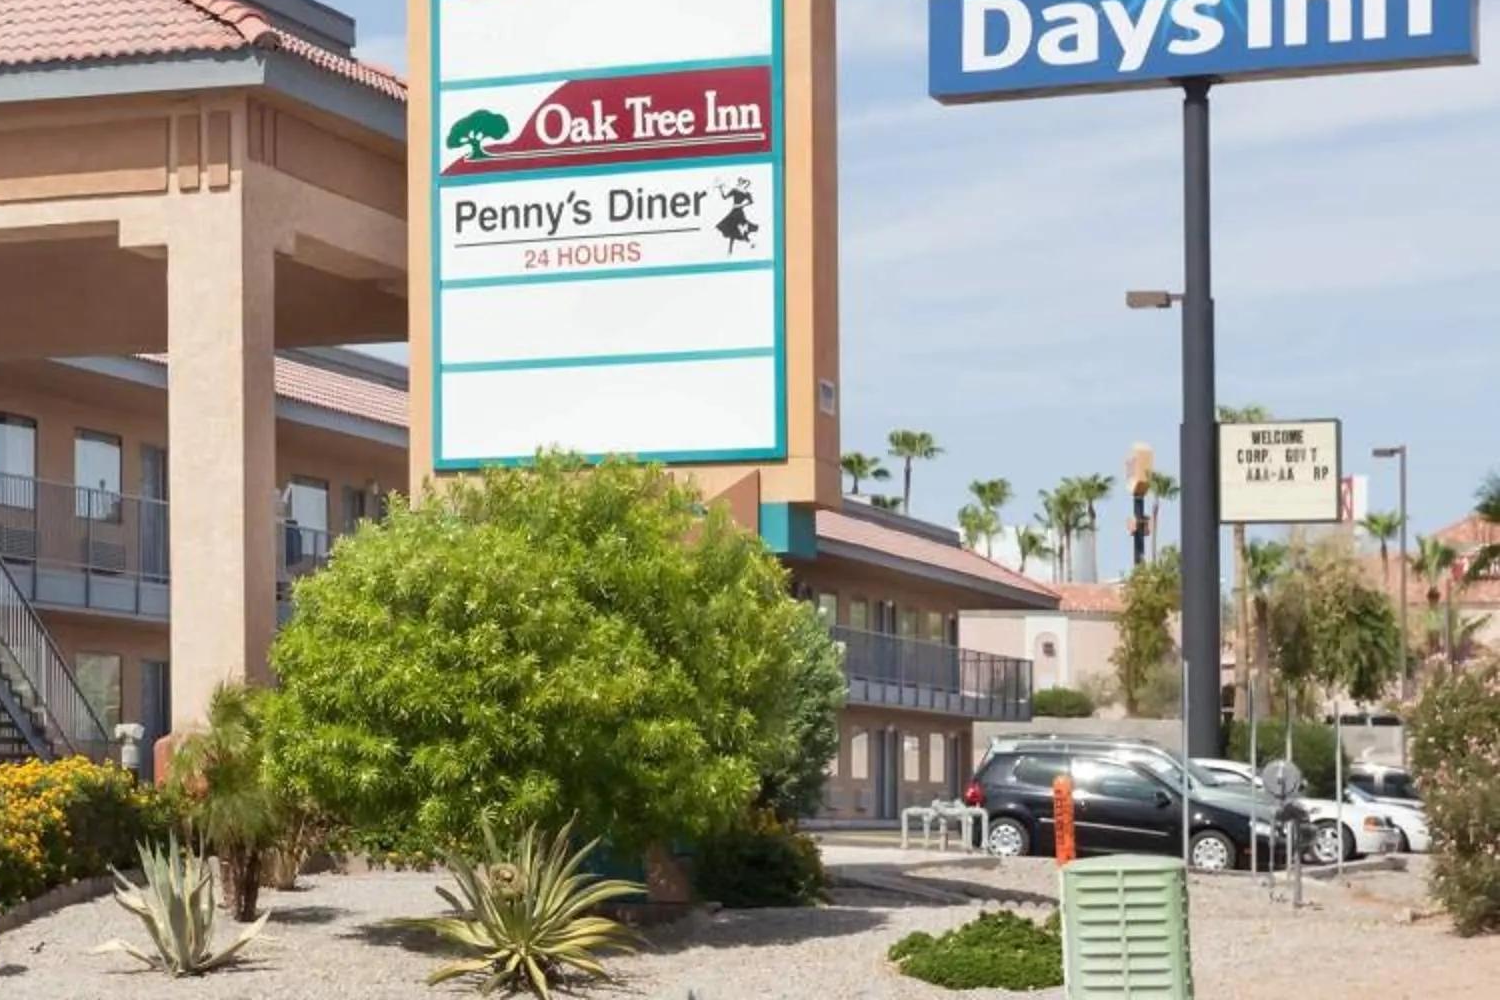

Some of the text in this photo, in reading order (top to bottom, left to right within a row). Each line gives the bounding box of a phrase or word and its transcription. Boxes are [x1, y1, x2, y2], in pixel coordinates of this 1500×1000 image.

[535, 89, 762, 145] Oak Tree Inn
[455, 188, 707, 235] Penny's Diner
[524, 242, 642, 269] 24 HOURS
[1251, 430, 1304, 445] WELCOME
